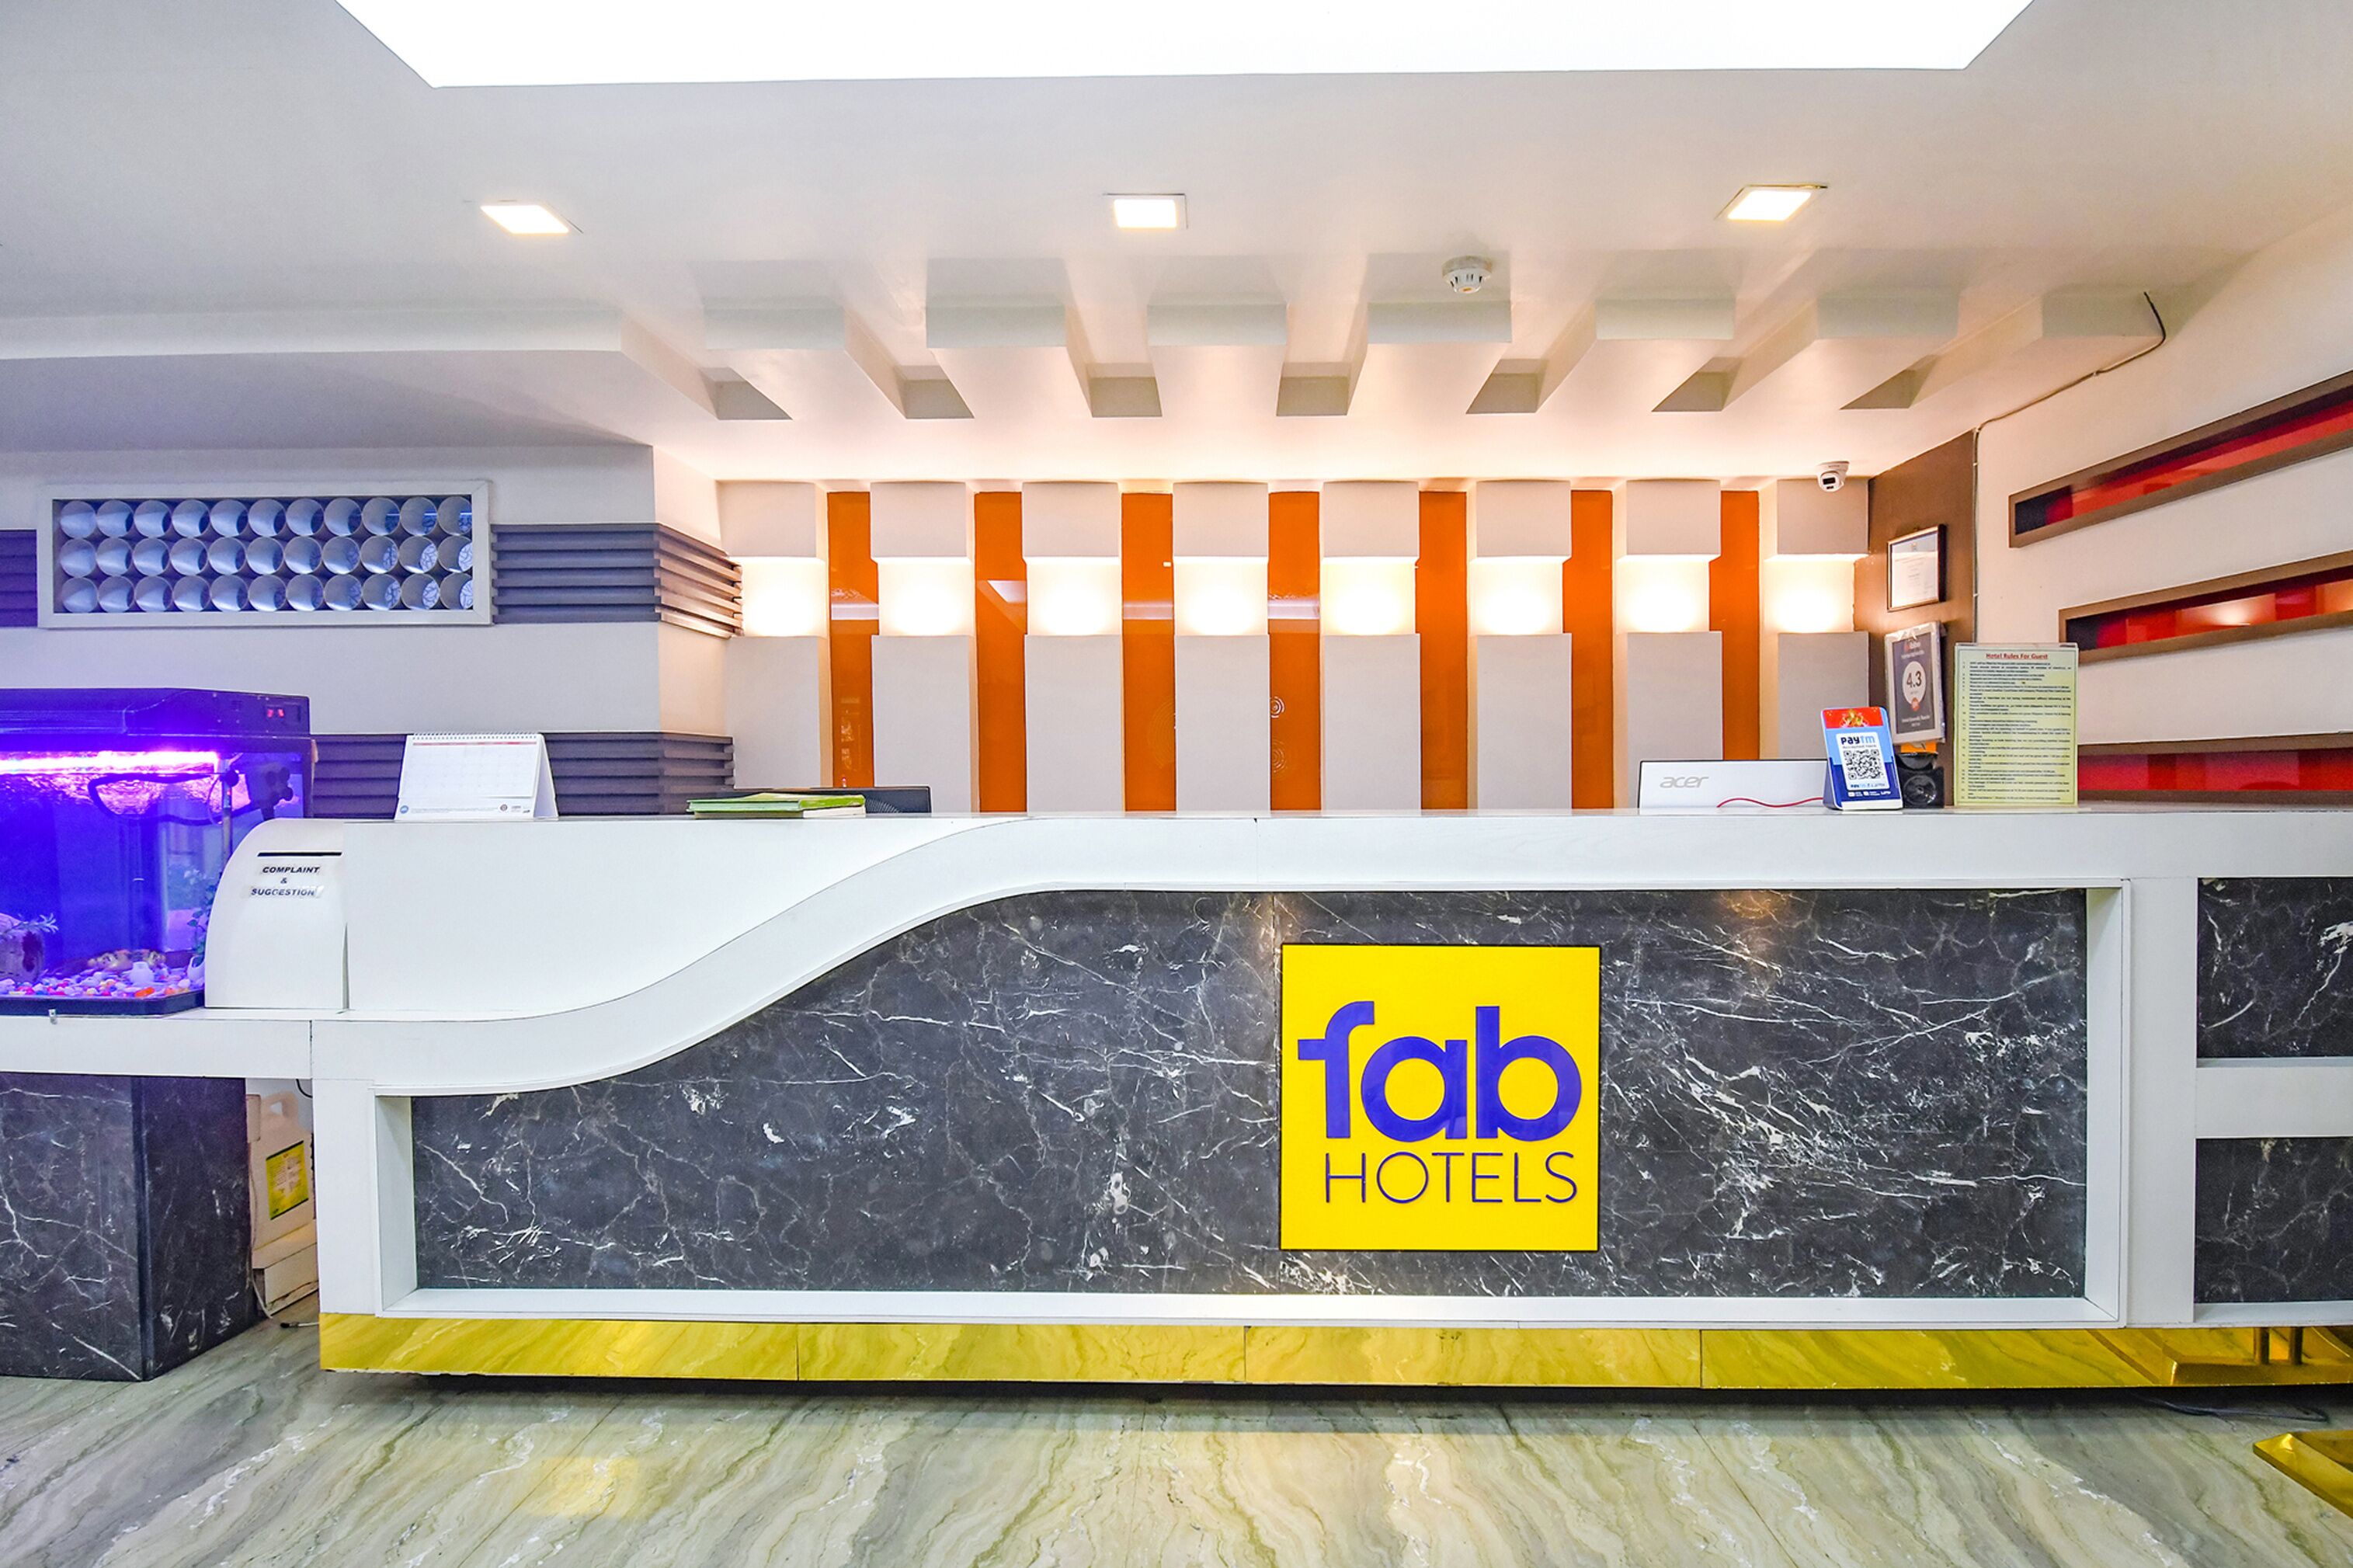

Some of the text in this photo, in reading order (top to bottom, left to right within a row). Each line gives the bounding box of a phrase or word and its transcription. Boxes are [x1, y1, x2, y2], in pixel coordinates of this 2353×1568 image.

[1906, 671, 1922, 688] 4.3
[1660, 777, 1709, 788] acer
[1298, 1001, 1582, 1142] fab
[1326, 1151, 1577, 1204] HOTELS
